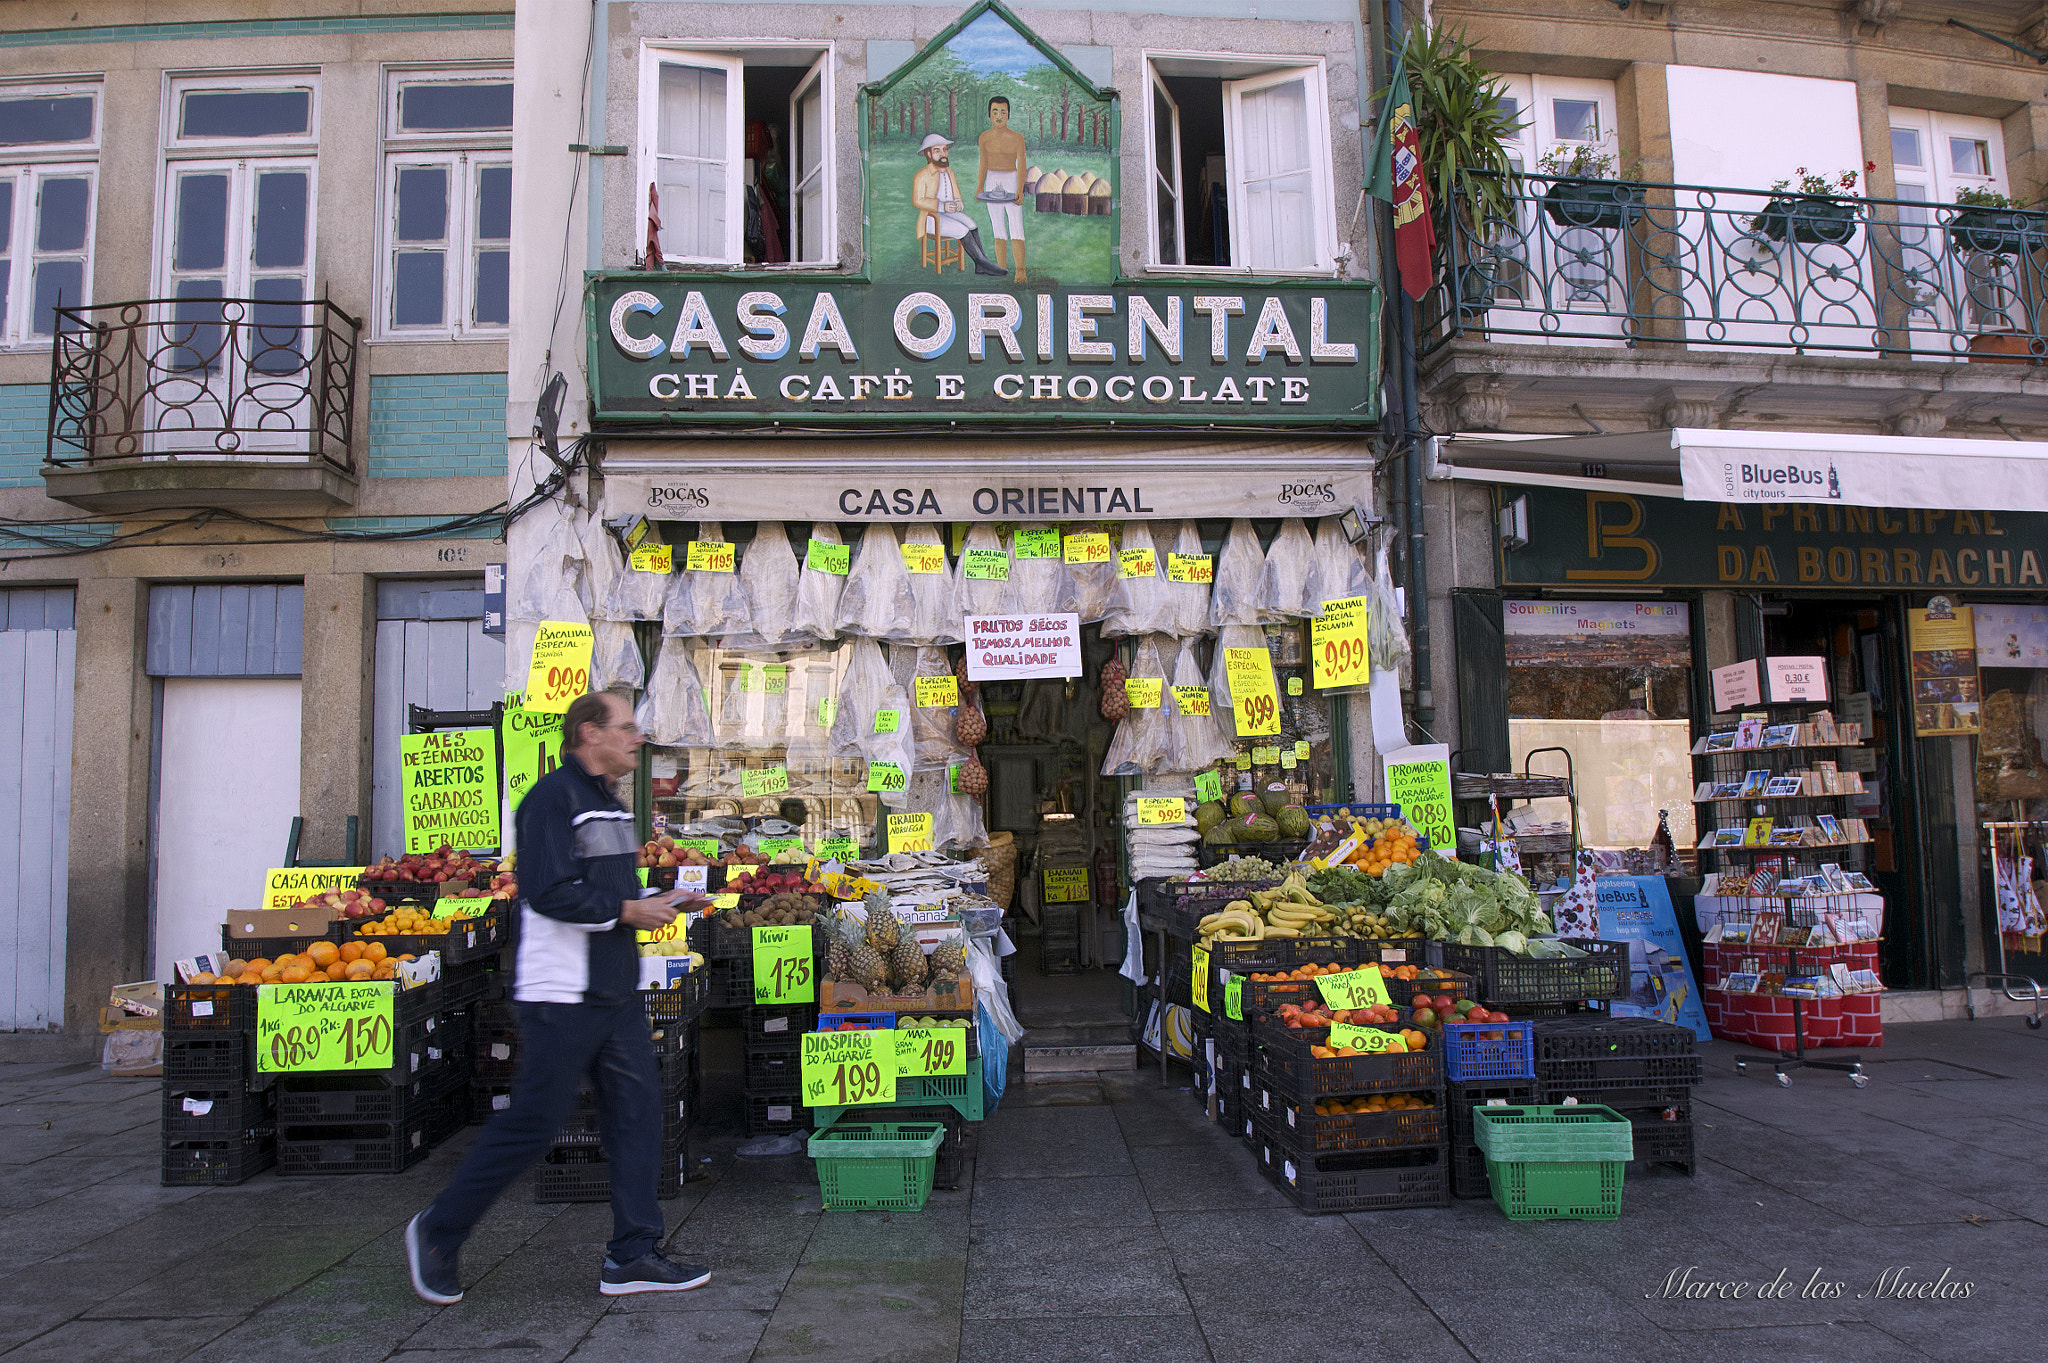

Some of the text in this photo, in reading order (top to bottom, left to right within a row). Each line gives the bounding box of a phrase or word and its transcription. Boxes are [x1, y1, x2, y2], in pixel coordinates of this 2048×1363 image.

[609, 290, 1359, 364] CASA ORIENTAL
[779, 367, 913, 401] CAFÉ
[935, 374, 965, 401] E
[993, 373, 1310, 403] CHOCOLATE
[1585, 464, 1604, 476] 113
[1741, 464, 1823, 485] BlueBus
[1723, 463, 1733, 497] PORTO
[648, 487, 709, 508] POÇAS
[1278, 483, 1336, 504] POÇAS
[1743, 489, 1785, 500] city tours
[839, 487, 1154, 517] CASA ORIENTAL
[1716, 502, 2005, 535] A PRINCIPAL
[1717, 545, 2045, 584] DA BORRACHA
[1509, 602, 1678, 616] Souvenirs Postal
[973, 619, 1023, 634] FRUTOS
[1577, 619, 1636, 632] Magnets
[535, 641, 579, 649] ESPECIAL
[1785, 673, 1810, 682] 0,30 €
[404, 747, 484, 766] DEZEMBRO
[414, 766, 484, 788] ABERTOS
[1394, 777, 1408, 787] DO
[410, 789, 483, 812] SABADOS
[1395, 787, 1437, 800] LARANJA
[1403, 792, 1445, 805] DO ALGARVE
[413, 810, 490, 830] DOMINGOS
[889, 813, 926, 826] GRAUDO
[411, 837, 419, 851] E
[271, 873, 309, 889] CASA
[272, 895, 301, 908] ESTA
[896, 910, 947, 924] bananas
[759, 930, 790, 944] Kiwi
[274, 987, 381, 1005] LARANJA EXTRA
[292, 1000, 375, 1016] DO ALGARVE
[805, 1033, 872, 1054] DIOSPIRO
[895, 1047, 917, 1056] SMITH
[805, 1049, 873, 1066] DO ALGARVE
[807, 1078, 825, 1100] KG
